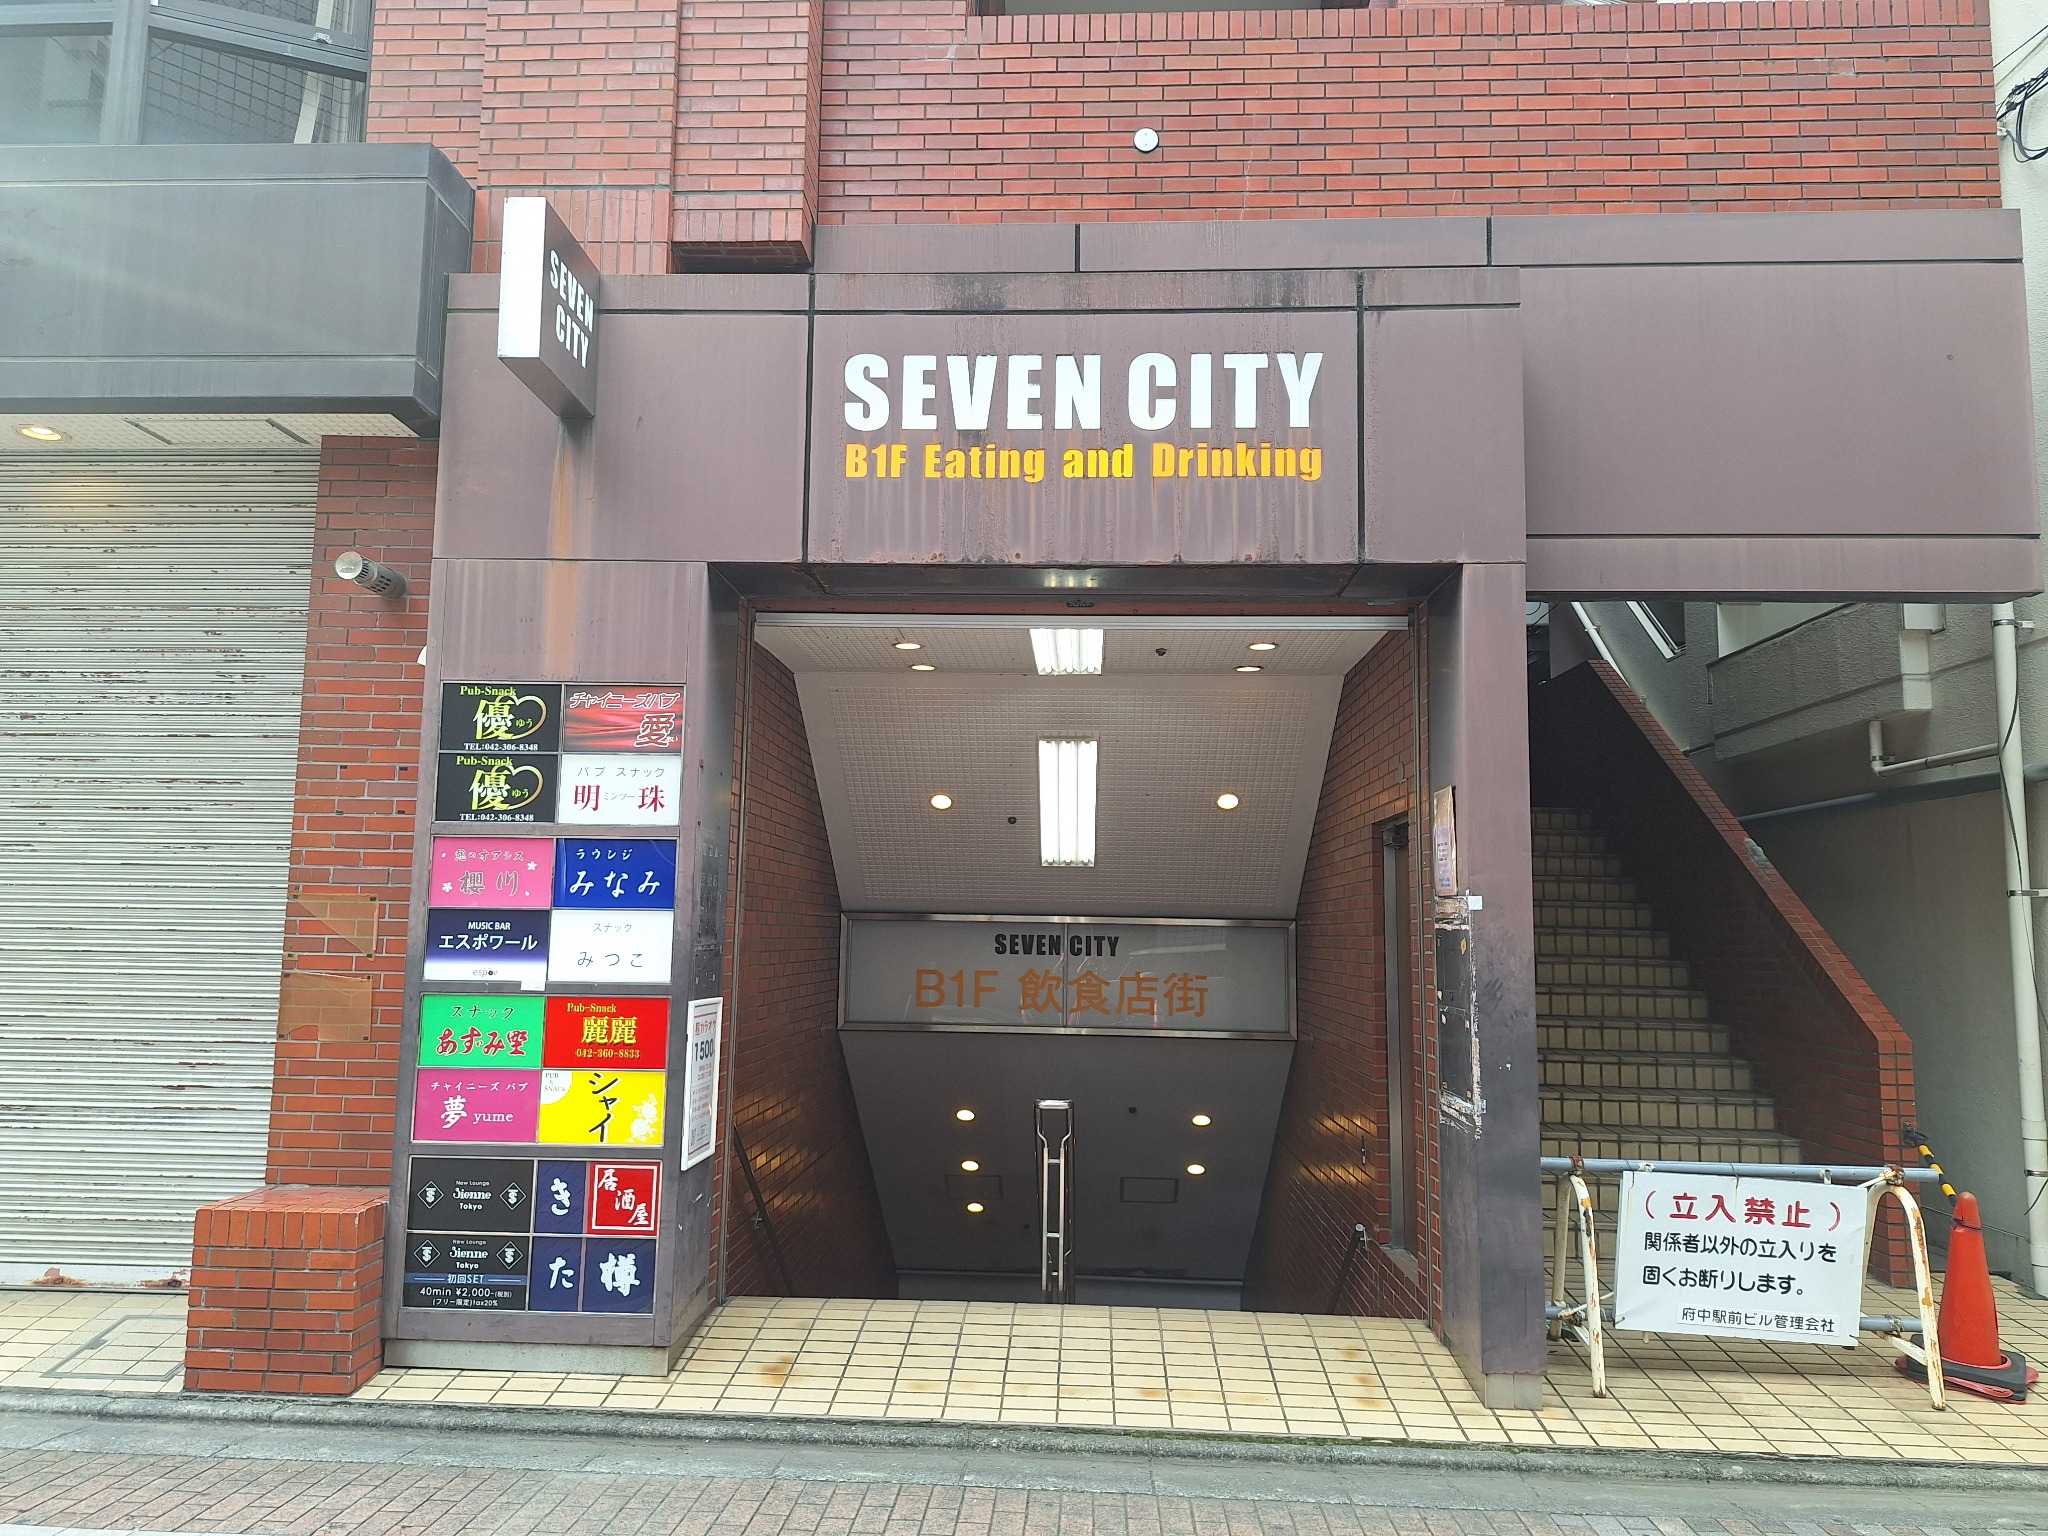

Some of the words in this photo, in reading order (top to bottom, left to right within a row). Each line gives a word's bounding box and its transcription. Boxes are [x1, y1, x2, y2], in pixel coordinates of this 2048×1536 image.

[550, 249, 594, 333] SEVEN
[555, 303, 589, 369] CITY
[844, 353, 1101, 431] SEVEN
[1128, 352, 1324, 430] CITY
[845, 443, 907, 478] B1F
[924, 443, 1045, 482] Eating
[1062, 443, 1133, 478] and
[1153, 442, 1322, 481] Drinking
[460, 685, 517, 696] Pub-Snack
[569, 691, 680, 709] チャイニーズパブ
[473, 699, 516, 740] 優
[516, 718, 533, 729] ゆう
[634, 713, 676, 748] 愛
[463, 742, 539, 751] TEL:042-306-8348
[456, 755, 513, 766] Pub-Snack
[616, 767, 665, 778] スナック
[468, 769, 512, 811] 優
[511, 788, 529, 799] ゆう
[573, 784, 601, 812] 明
[637, 784, 666, 812] 珠
[459, 813, 535, 822] TEL:042-306-8348
[575, 848, 633, 861] ラウンジ
[569, 870, 661, 898] みなみ
[467, 921, 493, 931] MUSIC
[494, 921, 511, 931] BAR
[592, 922, 633, 933] スナック
[438, 934, 538, 951] エスポワール
[995, 933, 1061, 956] SEVEN
[1069, 935, 1120, 957] CITY
[577, 951, 643, 968] みつこ
[914, 968, 999, 1009] B1F
[1018, 968, 1209, 1018] 飲食店街
[450, 1004, 515, 1020] スナック
[566, 1002, 617, 1013] Pub-Snack
[581, 1015, 638, 1046] 麗麗
[576, 1047, 641, 1059] 042-360-8833
[430, 1081, 500, 1092] チャイニーズ
[440, 1094, 467, 1129] 夢
[472, 1112, 514, 1125] yume
[588, 1072, 619, 1143] シャイ
[598, 1168, 650, 1226] 居酒屋
[459, 1202, 483, 1211] Tokyo
[1644, 1231, 1838, 1263] 関係者以外の立入りを
[455, 1261, 479, 1270] Tokyo
[447, 1273, 485, 1284] 初回SET
[1642, 1265, 1804, 1296] 固くお断りします。
[419, 1286, 452, 1296] 40min
[1681, 1307, 1836, 1334] 府中駅前ビル管理会社
